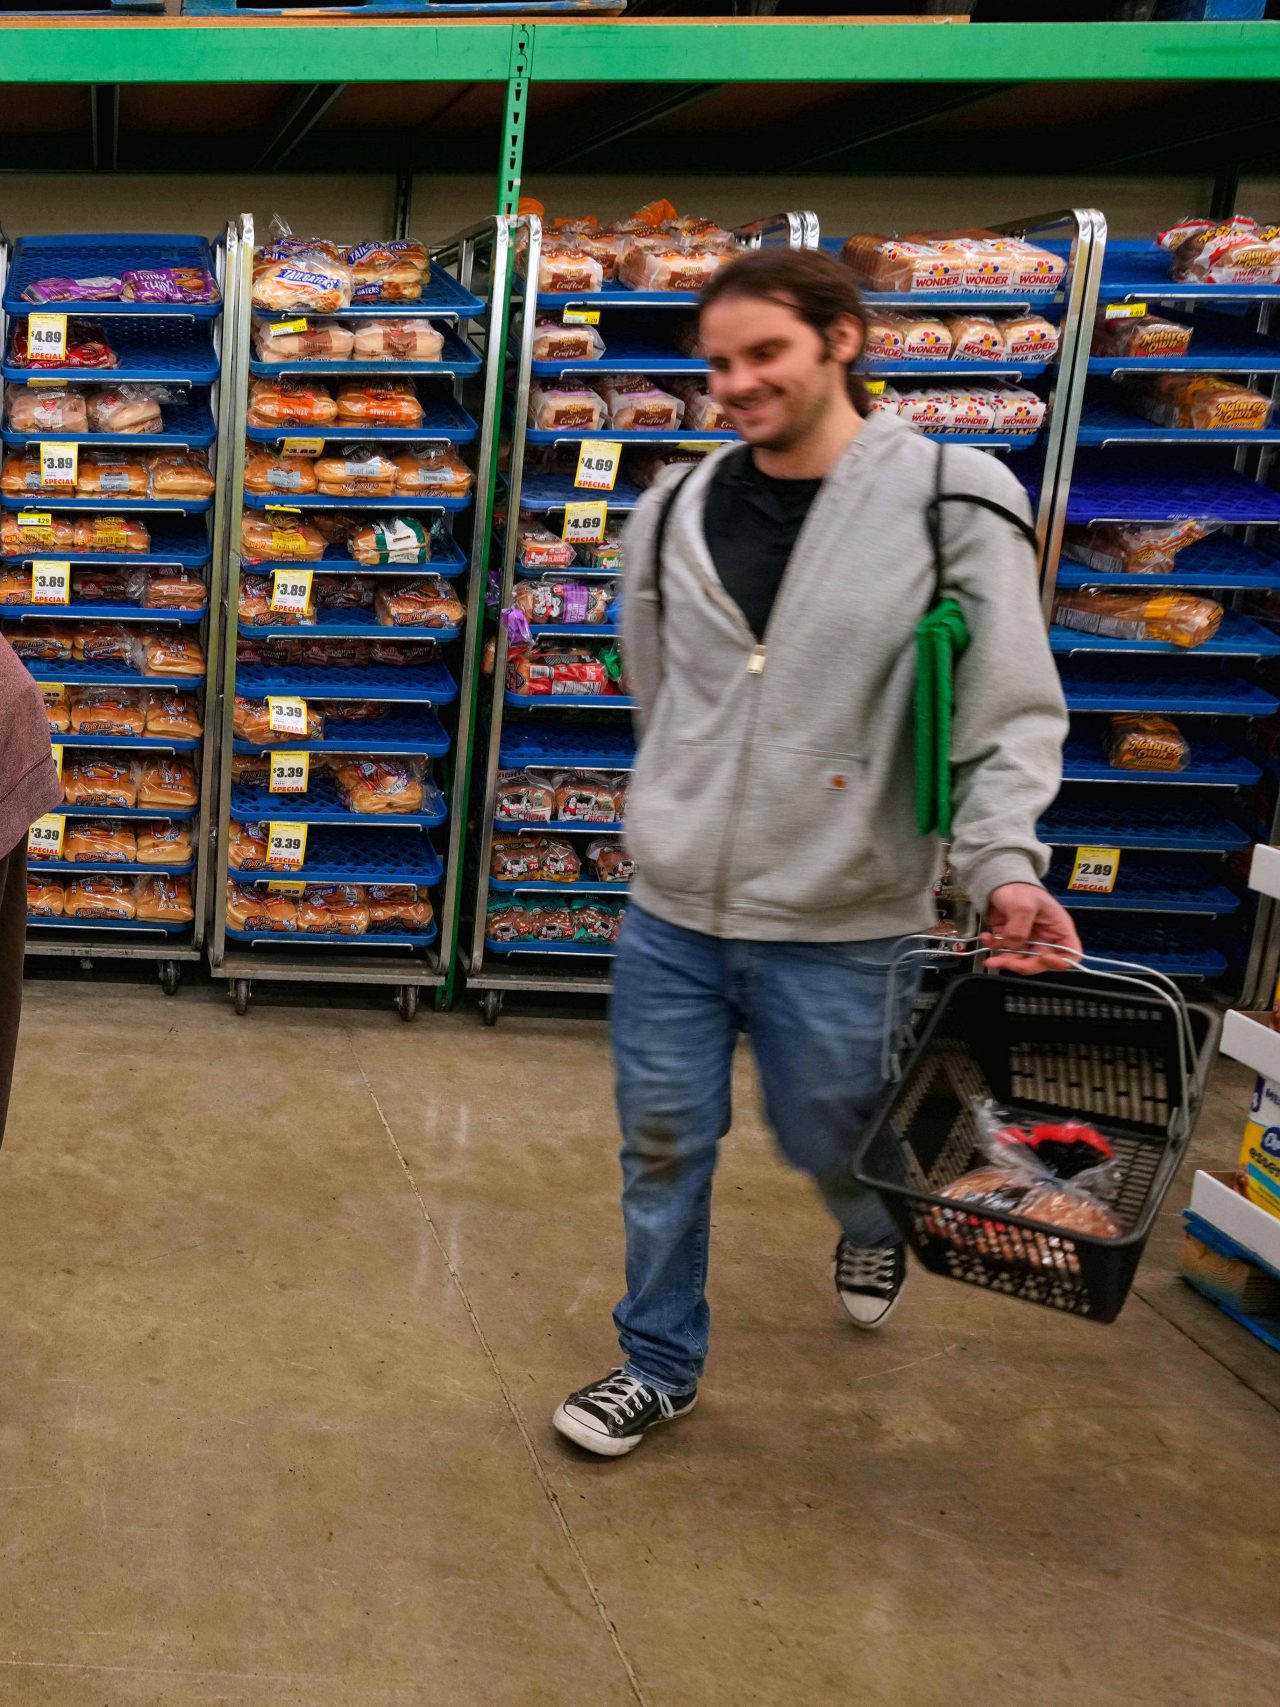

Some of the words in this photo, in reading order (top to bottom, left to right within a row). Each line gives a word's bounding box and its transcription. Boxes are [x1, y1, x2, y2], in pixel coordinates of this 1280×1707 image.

[1236, 269, 1273, 278] WHOLE
[283, 270, 336, 289] TAILGATERS
[674, 279, 706, 289] Crafted
[916, 277, 959, 288] WONDER
[966, 276, 1008, 285] WONDER
[1020, 275, 1061, 284] WONDER
[556, 280, 584, 290] Crafted
[31, 330, 62, 343] $4.89
[908, 345, 948, 354] WONDER
[963, 343, 1001, 359] WONDER
[1011, 342, 1055, 354] WONDER
[1149, 340, 1177, 352] Own
[30, 352, 62, 360] SPECIAL
[553, 349, 580, 358] Crafted
[638, 414, 666, 424] Crafted
[912, 414, 946, 424] WONDER
[1224, 409, 1253, 421] Own
[560, 416, 588, 425] Crafted
[954, 417, 988, 425] WONDER
[1003, 417, 1037, 425] WONDER
[44, 457, 73, 469] $3.89
[580, 457, 613, 472] $4.69
[577, 480, 611, 489] SPECIAL
[567, 517, 601, 529] $4.69
[35, 576, 65, 588] $3.89
[277, 583, 307, 597] $3.89
[273, 604, 305, 613] SPECIAL
[272, 705, 303, 718] $3.39
[272, 724, 305, 734] SPECIAL
[273, 767, 304, 778] $3.39
[31, 827, 59, 841] $3.39
[271, 837, 301, 850] $3.39
[28, 846, 59, 855] SPECIAL
[269, 856, 301, 865] SPECIAL
[1078, 863, 1112, 876] $2.89
[1072, 883, 1110, 892] SPECIAL
